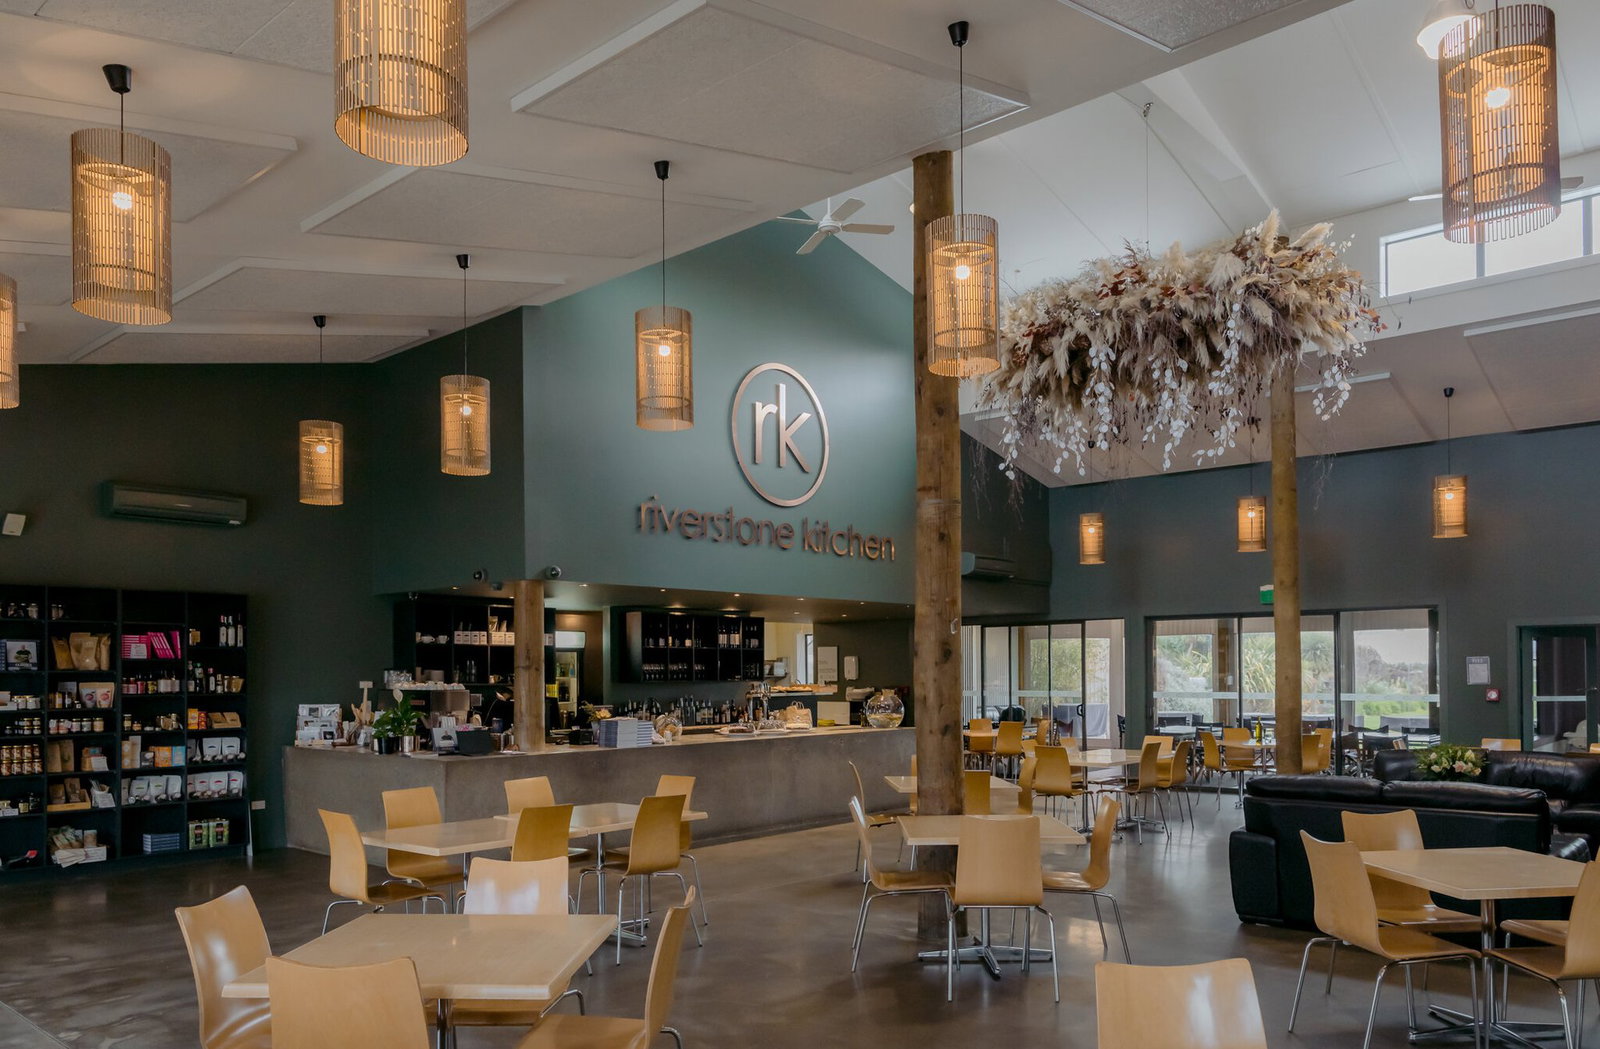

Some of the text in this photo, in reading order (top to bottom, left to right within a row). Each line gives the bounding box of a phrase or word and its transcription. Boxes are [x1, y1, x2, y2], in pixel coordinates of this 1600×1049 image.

[753, 383, 812, 473] rk
[637, 494, 896, 561] riverstone kitchen
